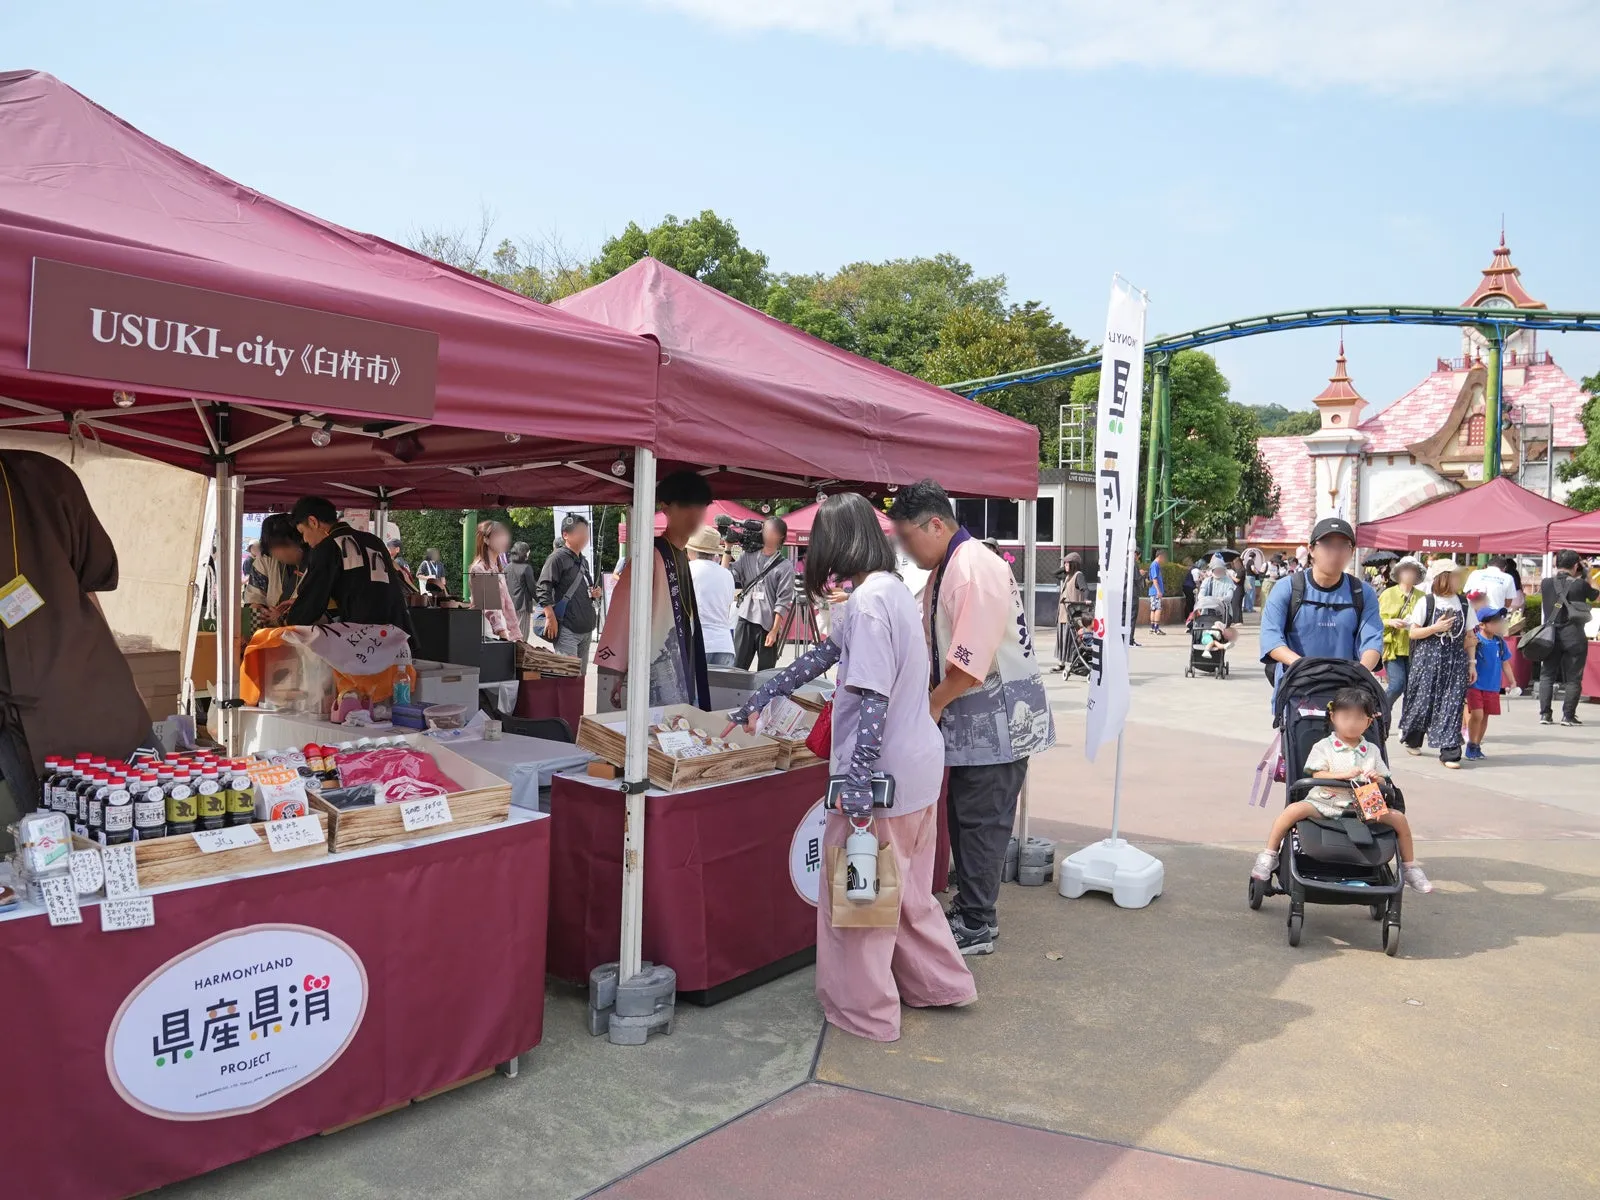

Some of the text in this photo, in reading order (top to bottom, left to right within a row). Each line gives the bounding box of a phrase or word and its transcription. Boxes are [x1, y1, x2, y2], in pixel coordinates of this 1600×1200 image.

[89, 308, 294, 376] USUKI-city
[194, 957, 293, 990] HARMONYLAND
[153, 975, 331, 1067] 県産県消
[220, 1051, 271, 1076] PROJECT
